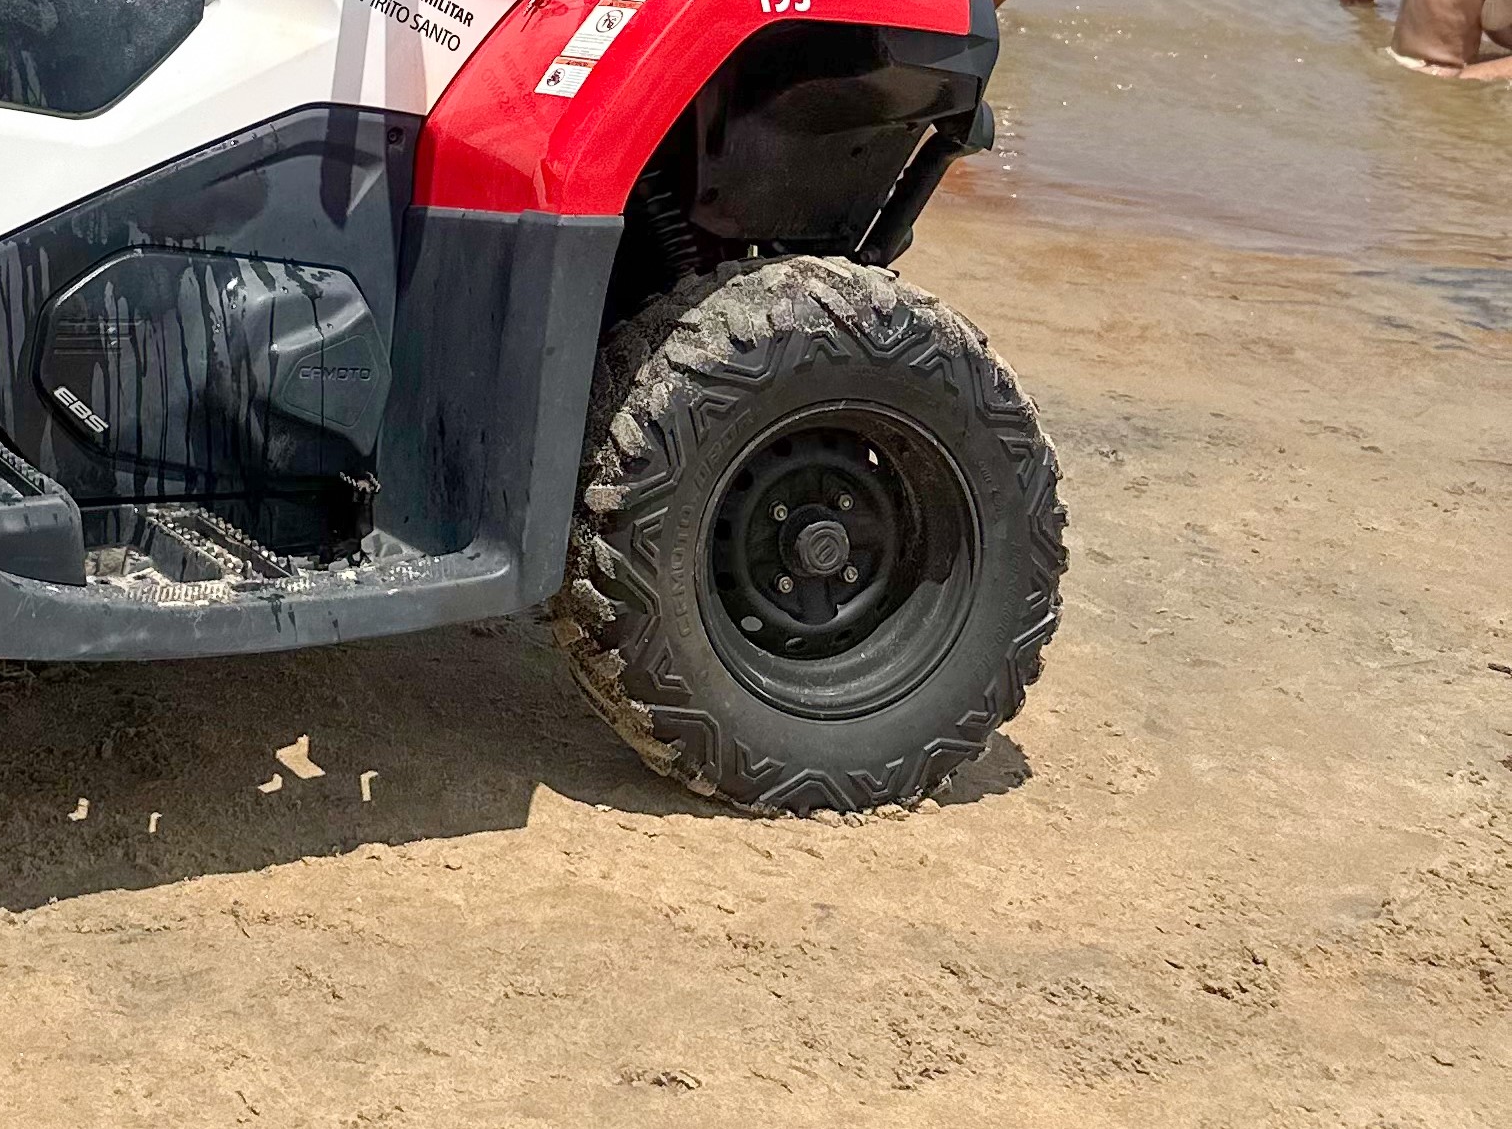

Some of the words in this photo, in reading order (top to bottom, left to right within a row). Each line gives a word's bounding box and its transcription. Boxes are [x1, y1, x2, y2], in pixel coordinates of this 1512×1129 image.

[409, 13, 461, 51] SANTO
[299, 365, 371, 381] CFMOTO
[53, 386, 109, 433] EBS
